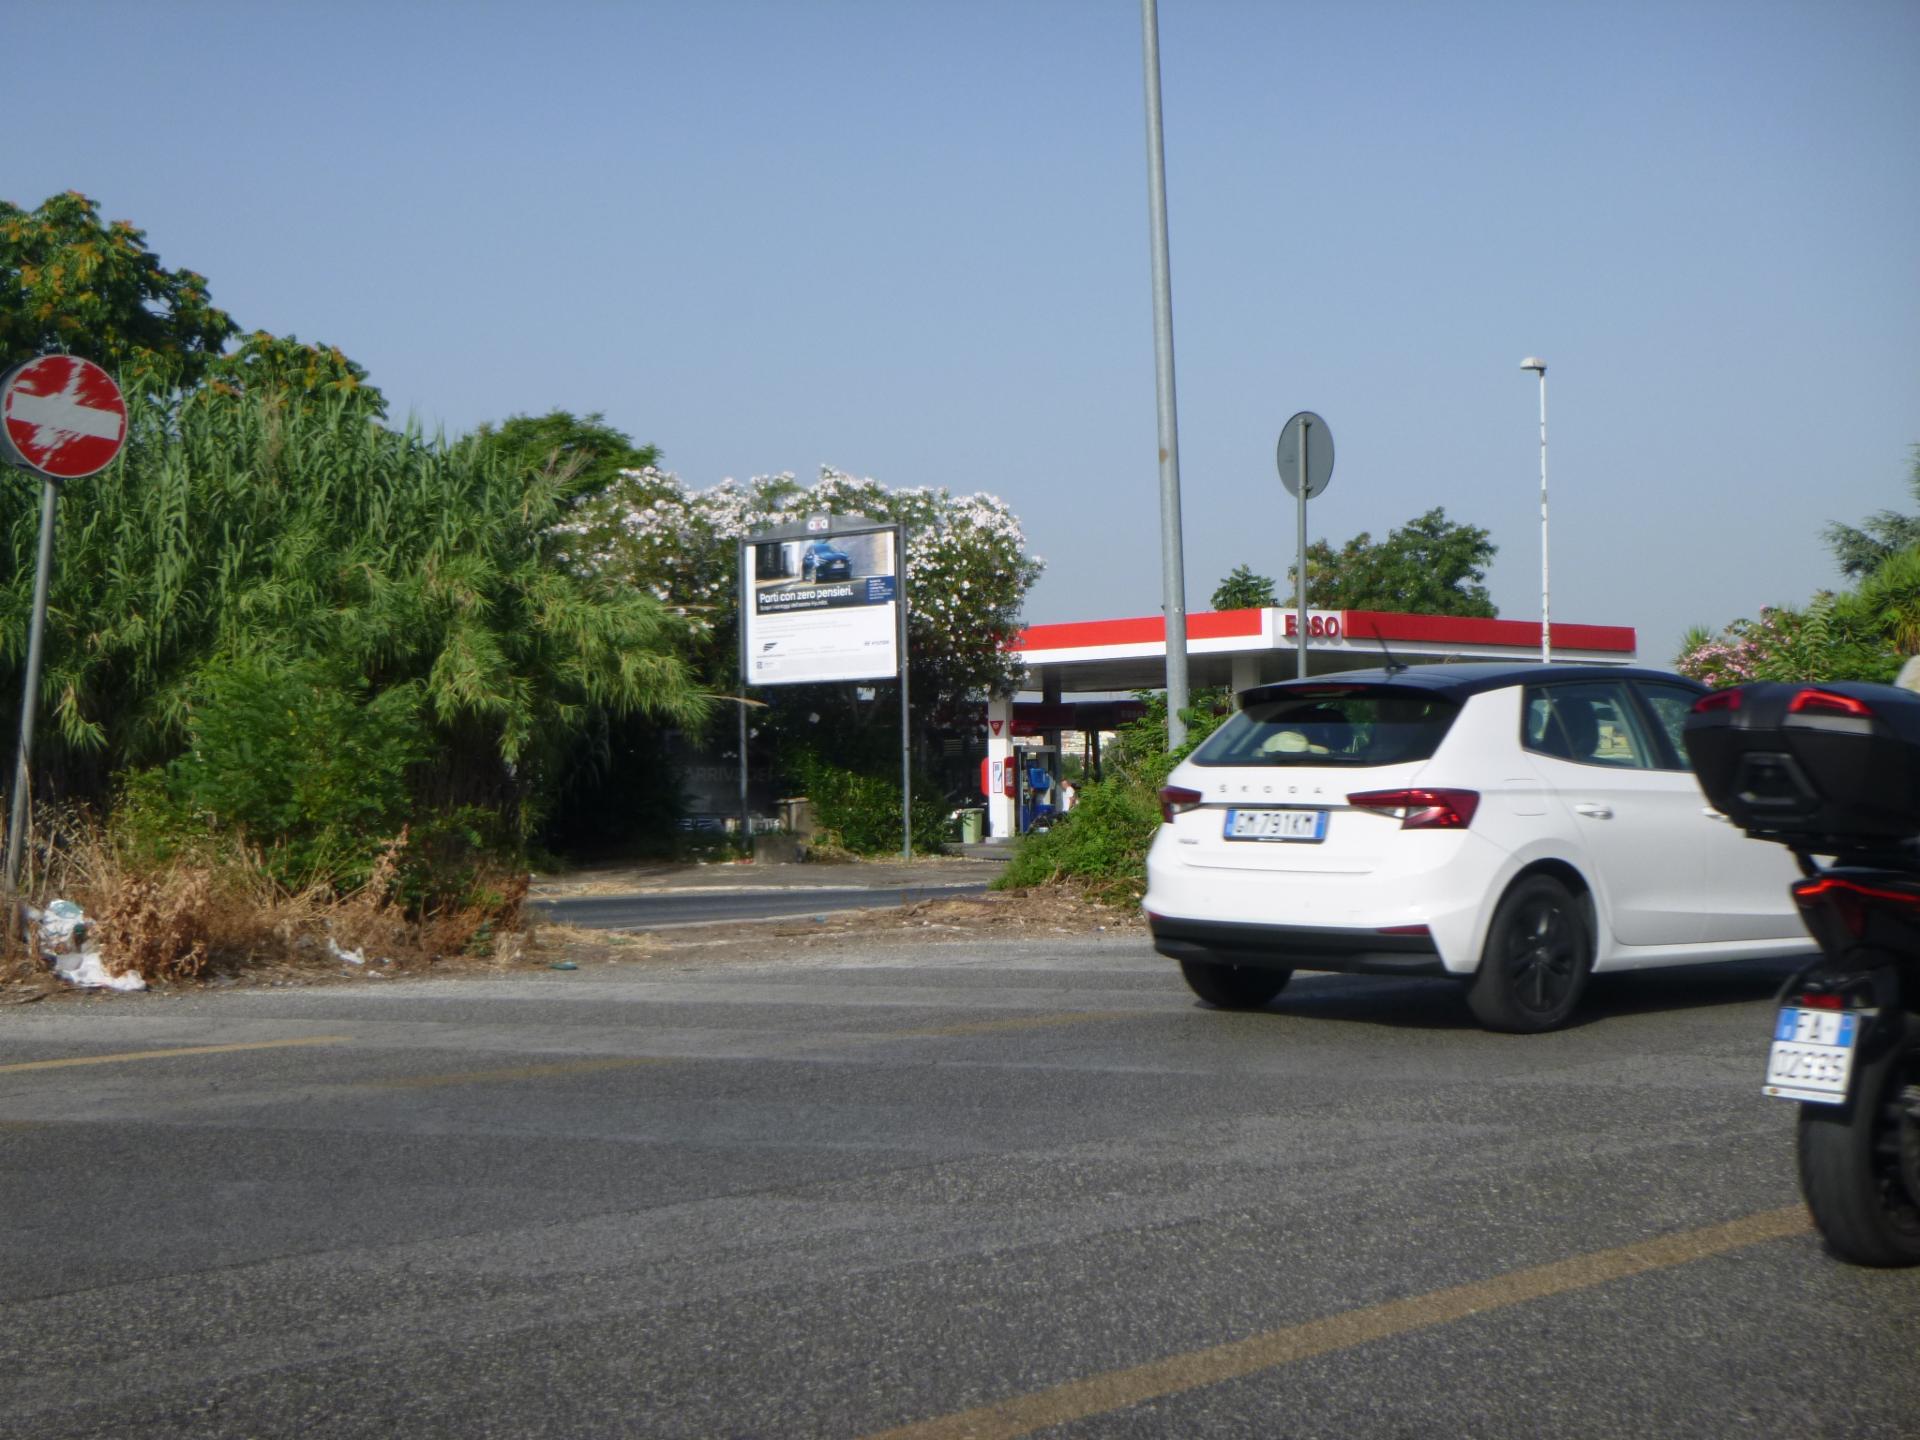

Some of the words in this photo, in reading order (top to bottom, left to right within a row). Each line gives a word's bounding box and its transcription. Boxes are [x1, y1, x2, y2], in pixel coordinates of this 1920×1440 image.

[759, 591, 779, 604] Parti
[780, 592, 796, 602] con
[796, 590, 816, 600] zero
[817, 585, 854, 599] pensieri.
